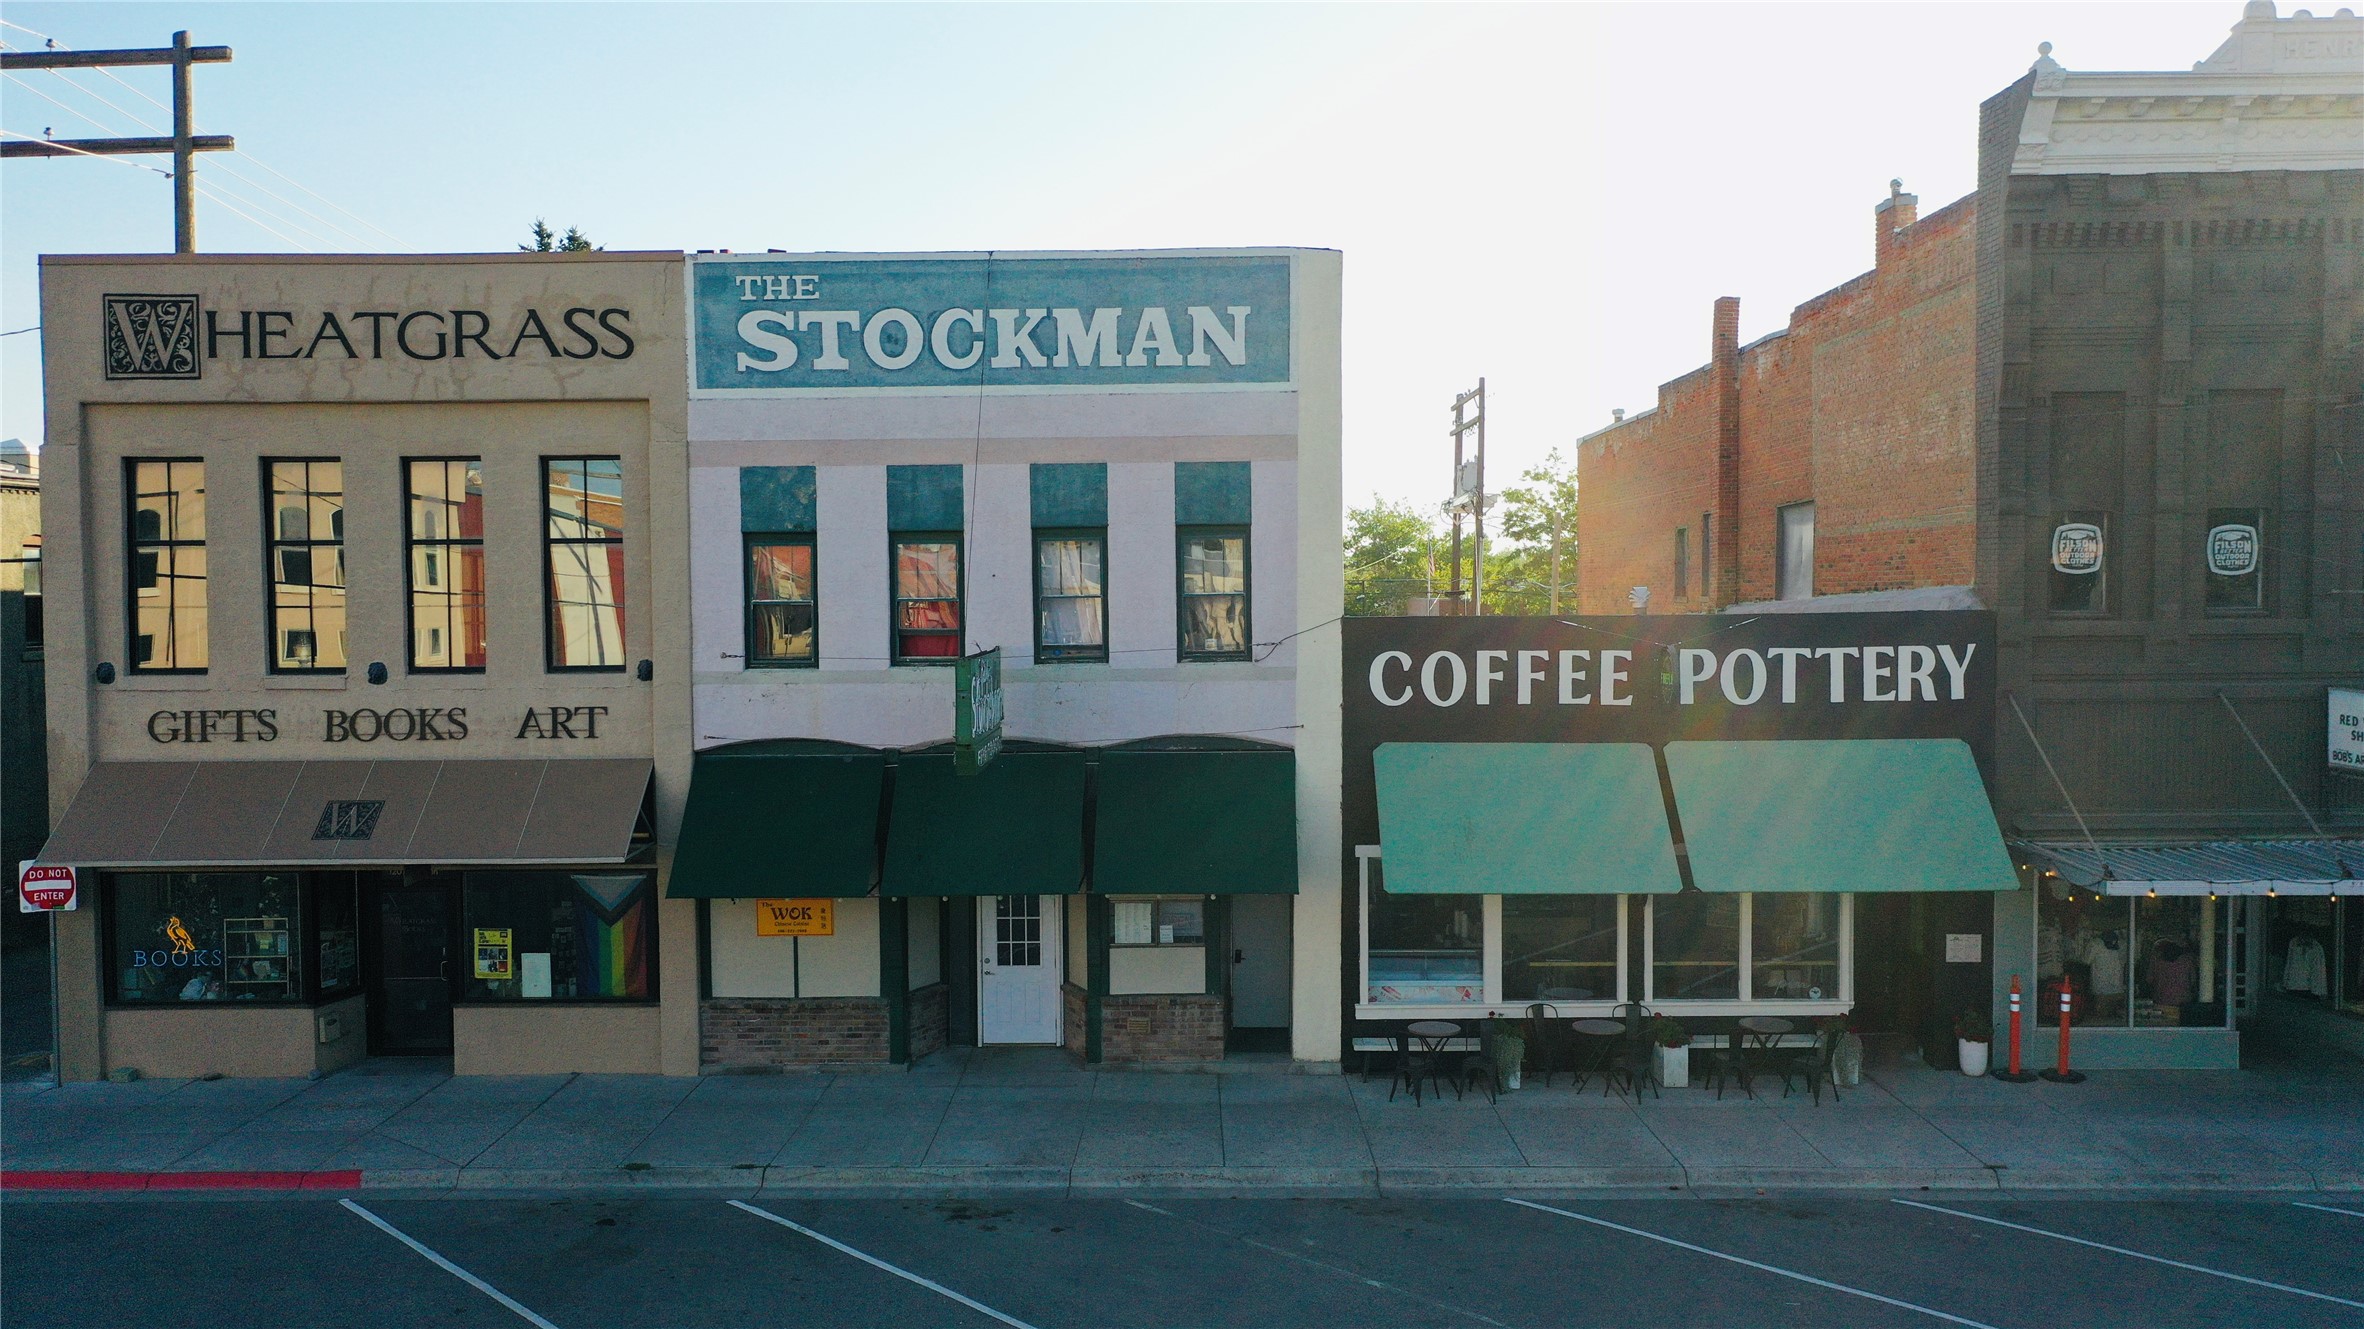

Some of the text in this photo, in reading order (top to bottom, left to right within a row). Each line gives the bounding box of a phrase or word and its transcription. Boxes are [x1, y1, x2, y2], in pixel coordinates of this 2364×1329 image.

[736, 274, 820, 300] THE
[104, 295, 635, 380] WHEATGRASS
[735, 305, 1251, 373] STOCKMAN
[2059, 539, 2097, 553] FILSON
[2214, 540, 2252, 554] FILSON
[1368, 643, 1977, 707] COFFEE POTTERY
[147, 706, 608, 743] GIFTS BOOKS ART
[2339, 714, 2359, 727] RED
[2332, 750, 2353, 763] BOB'S
[29, 869, 67, 879] DO NOT
[33, 892, 64, 901] ENTER
[771, 907, 812, 920] WOK
[133, 950, 222, 968] BOOKS
